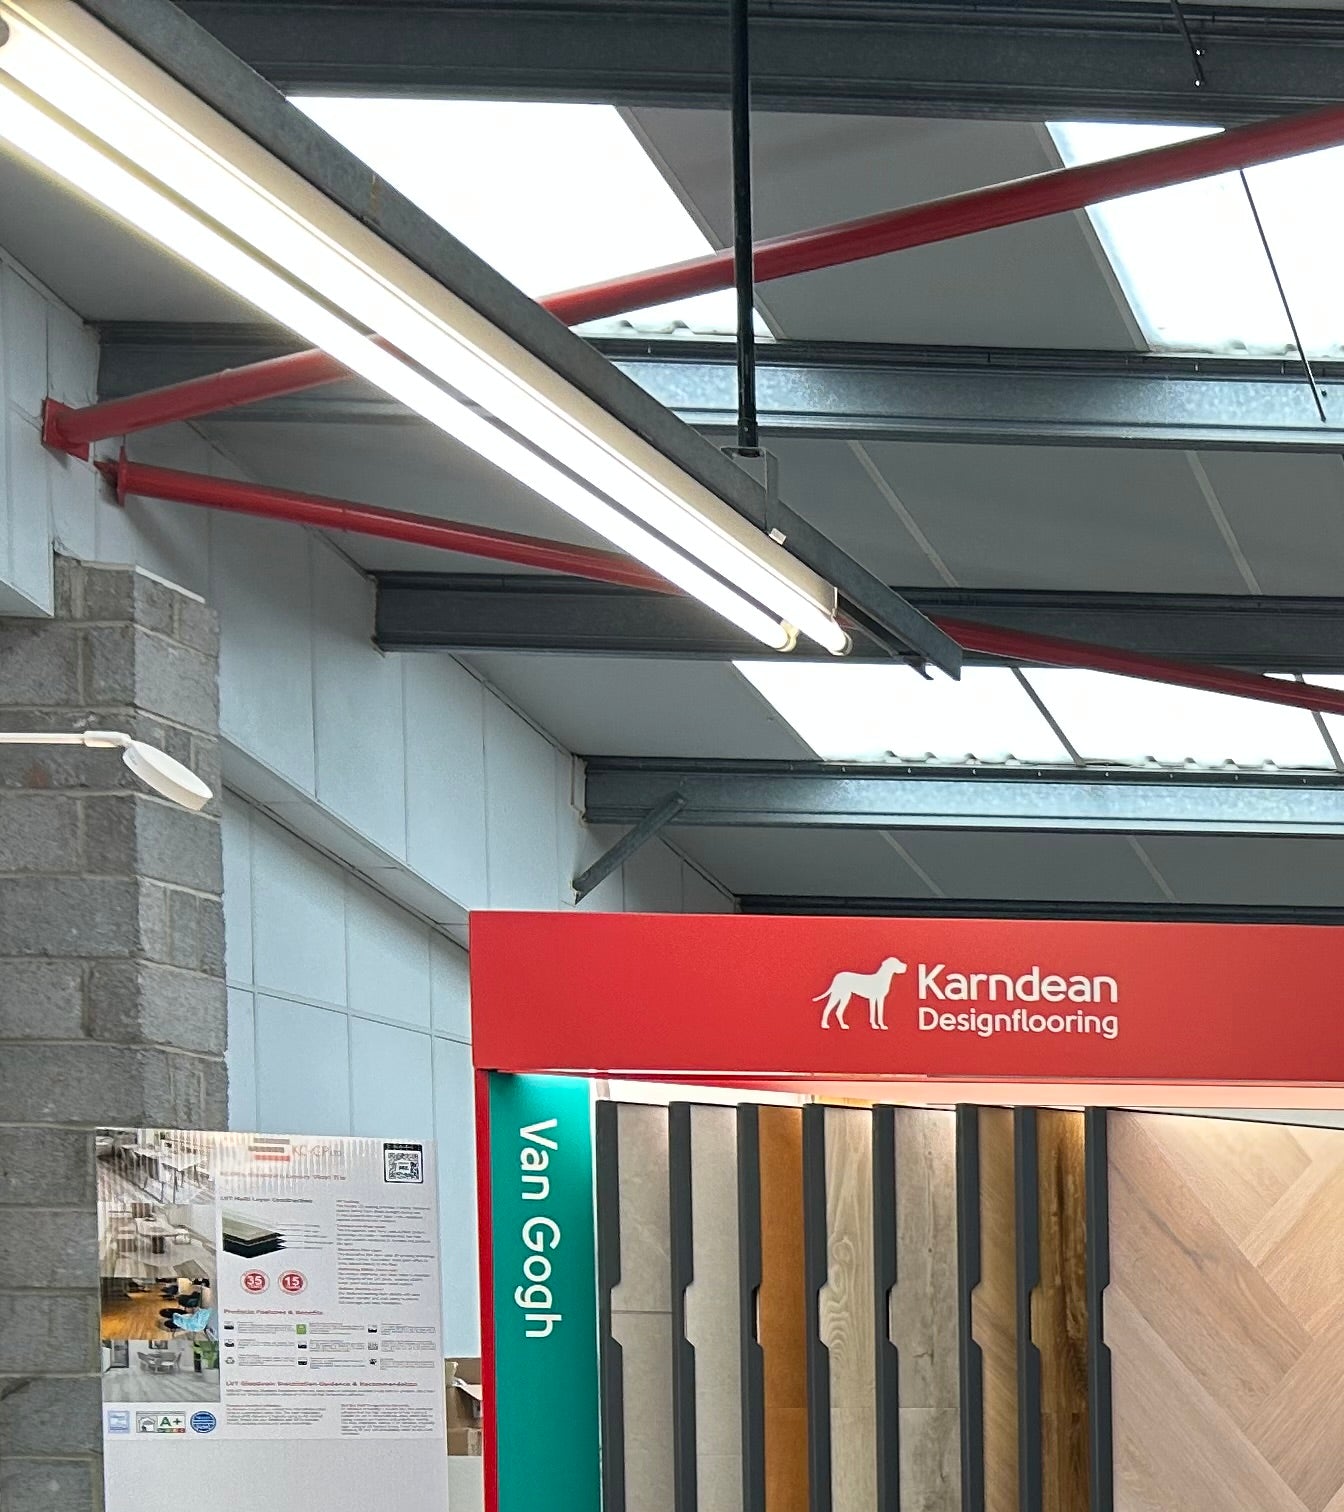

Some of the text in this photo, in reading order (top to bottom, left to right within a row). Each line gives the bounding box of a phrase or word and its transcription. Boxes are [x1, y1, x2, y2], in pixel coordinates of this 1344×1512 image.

[917, 963, 1118, 1003] Karndean
[917, 1006, 1119, 1040] Designflooring
[514, 1118, 562, 1339] Van Gogh
